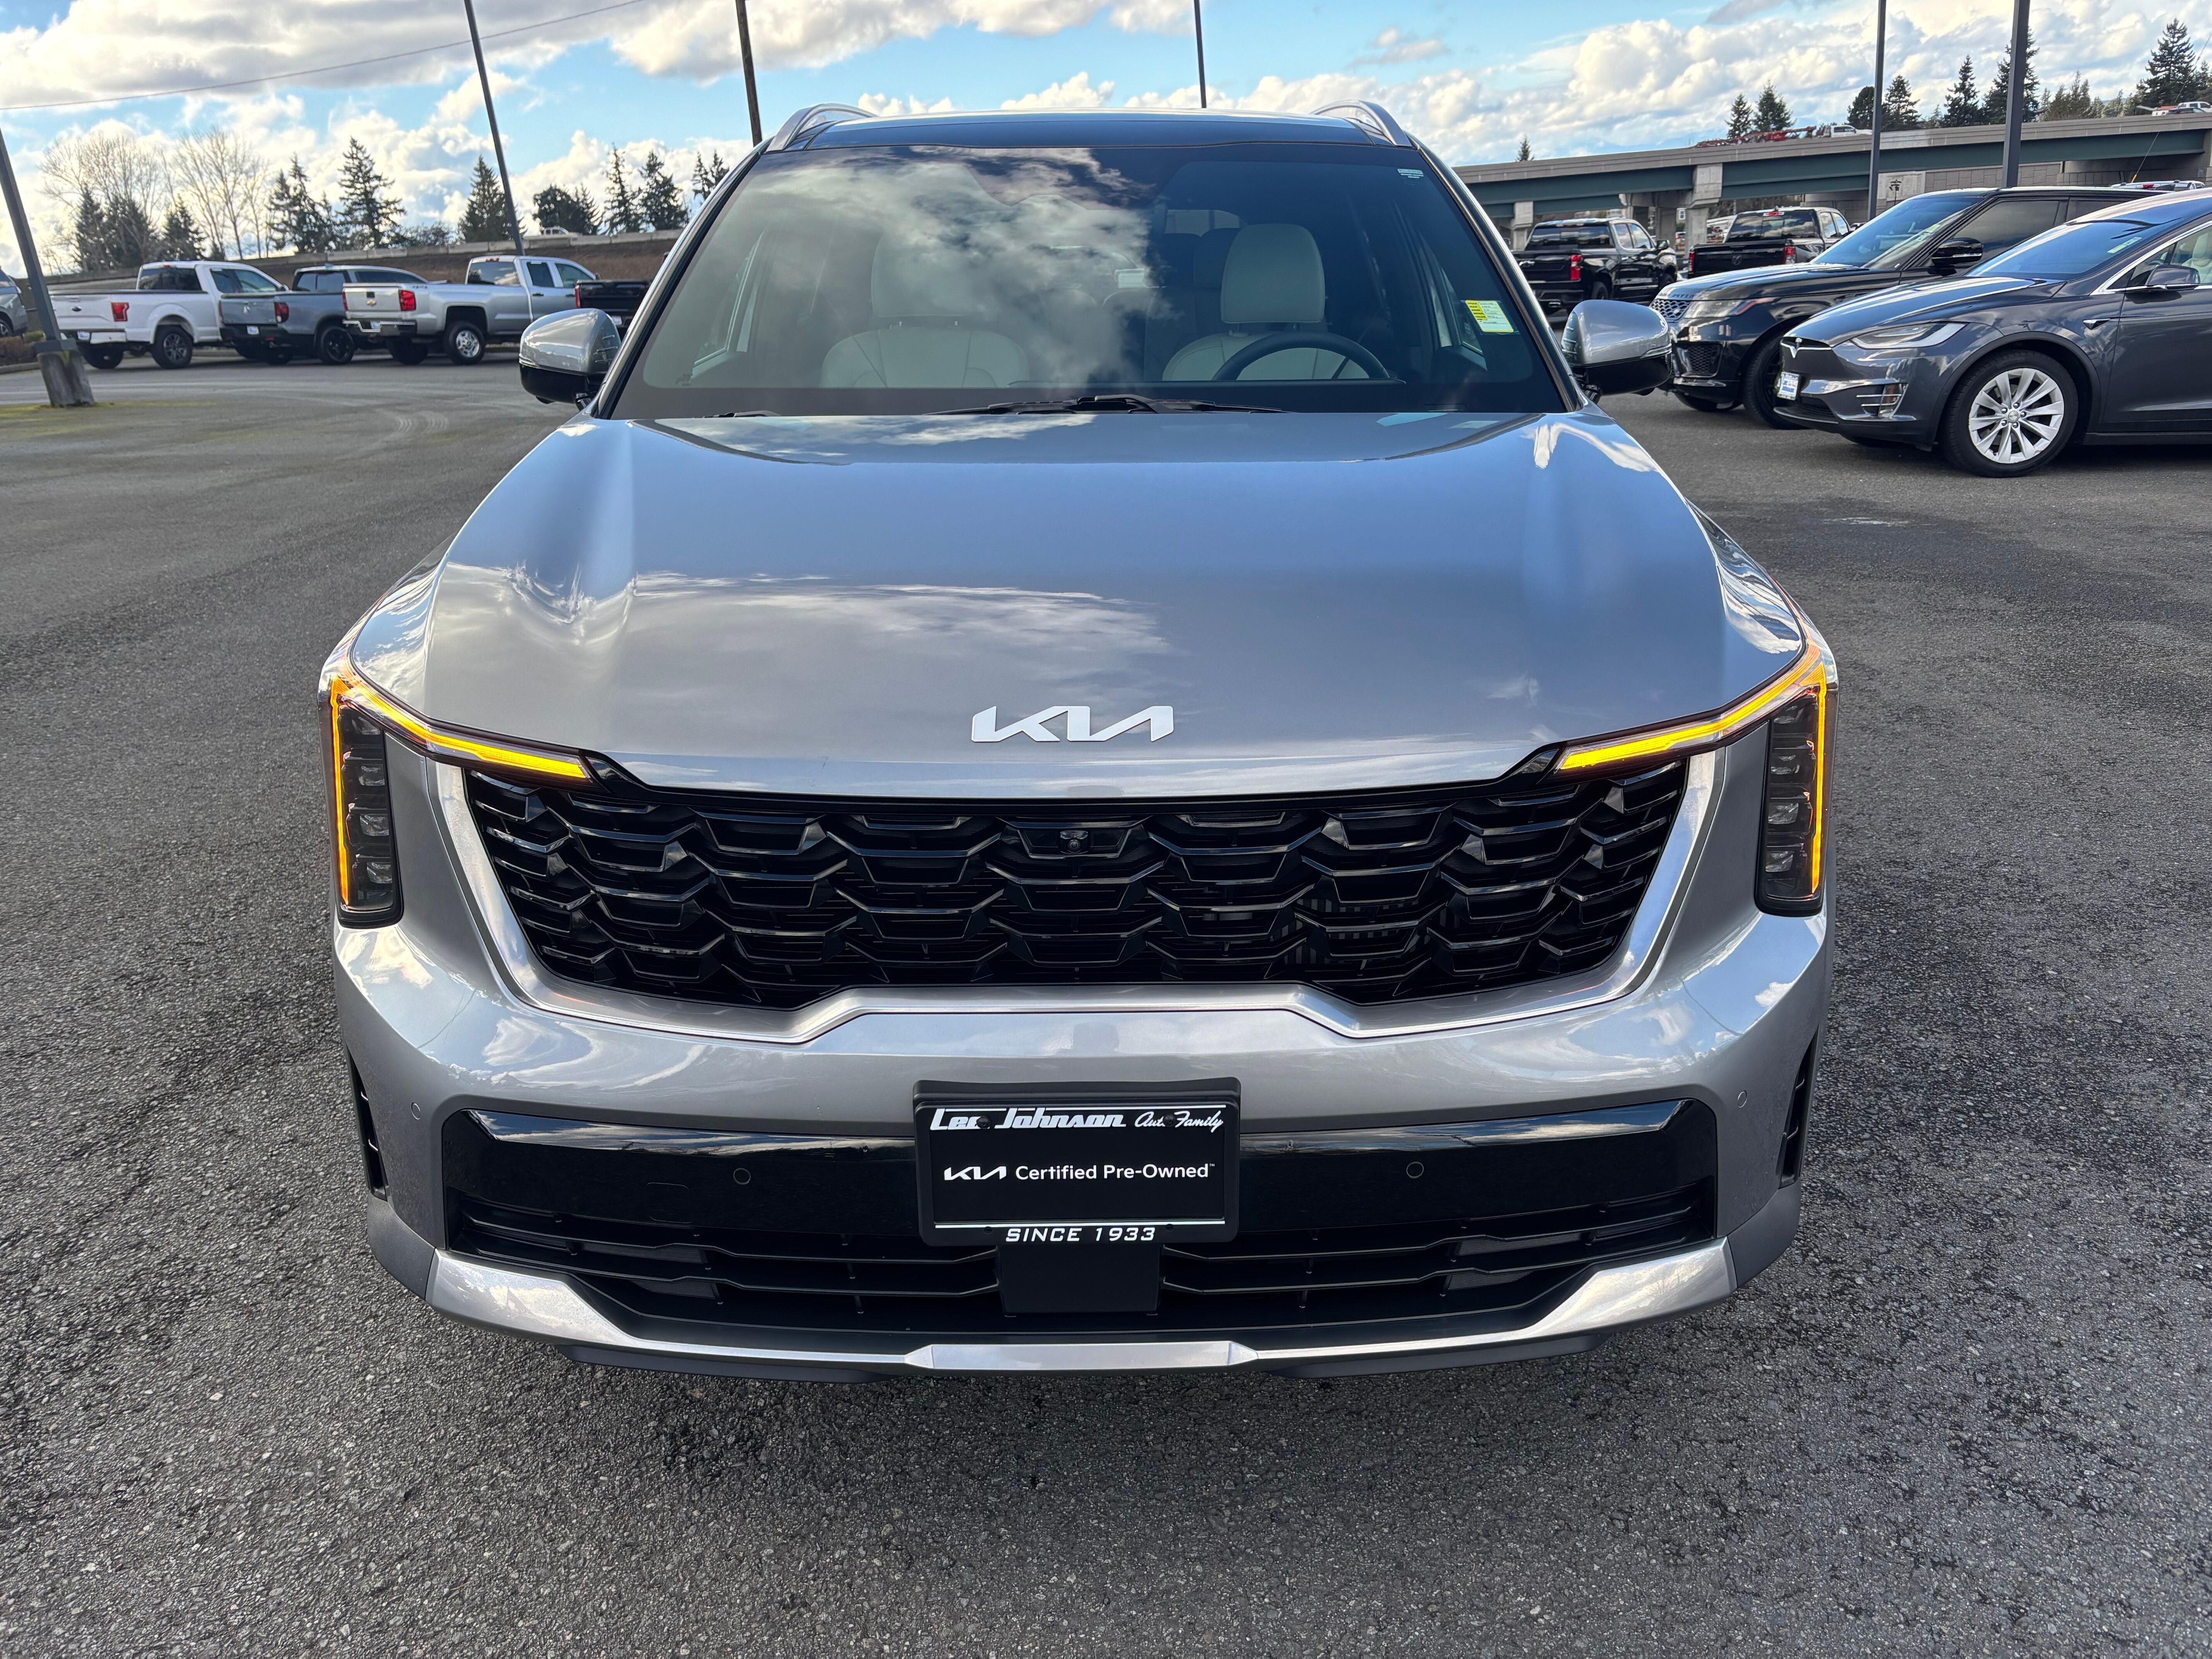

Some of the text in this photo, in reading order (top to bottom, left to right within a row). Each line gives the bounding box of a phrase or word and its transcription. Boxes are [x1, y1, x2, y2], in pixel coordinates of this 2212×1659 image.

[971, 706, 1173, 742] KIA
[994, 1108, 1127, 1129] Johnson
[1134, 1111, 1166, 1127] Aut
[1174, 1110, 1224, 1133] Family
[1015, 1165, 1097, 1180] Certified
[1006, 1227, 1156, 1242] SINCE 1933
